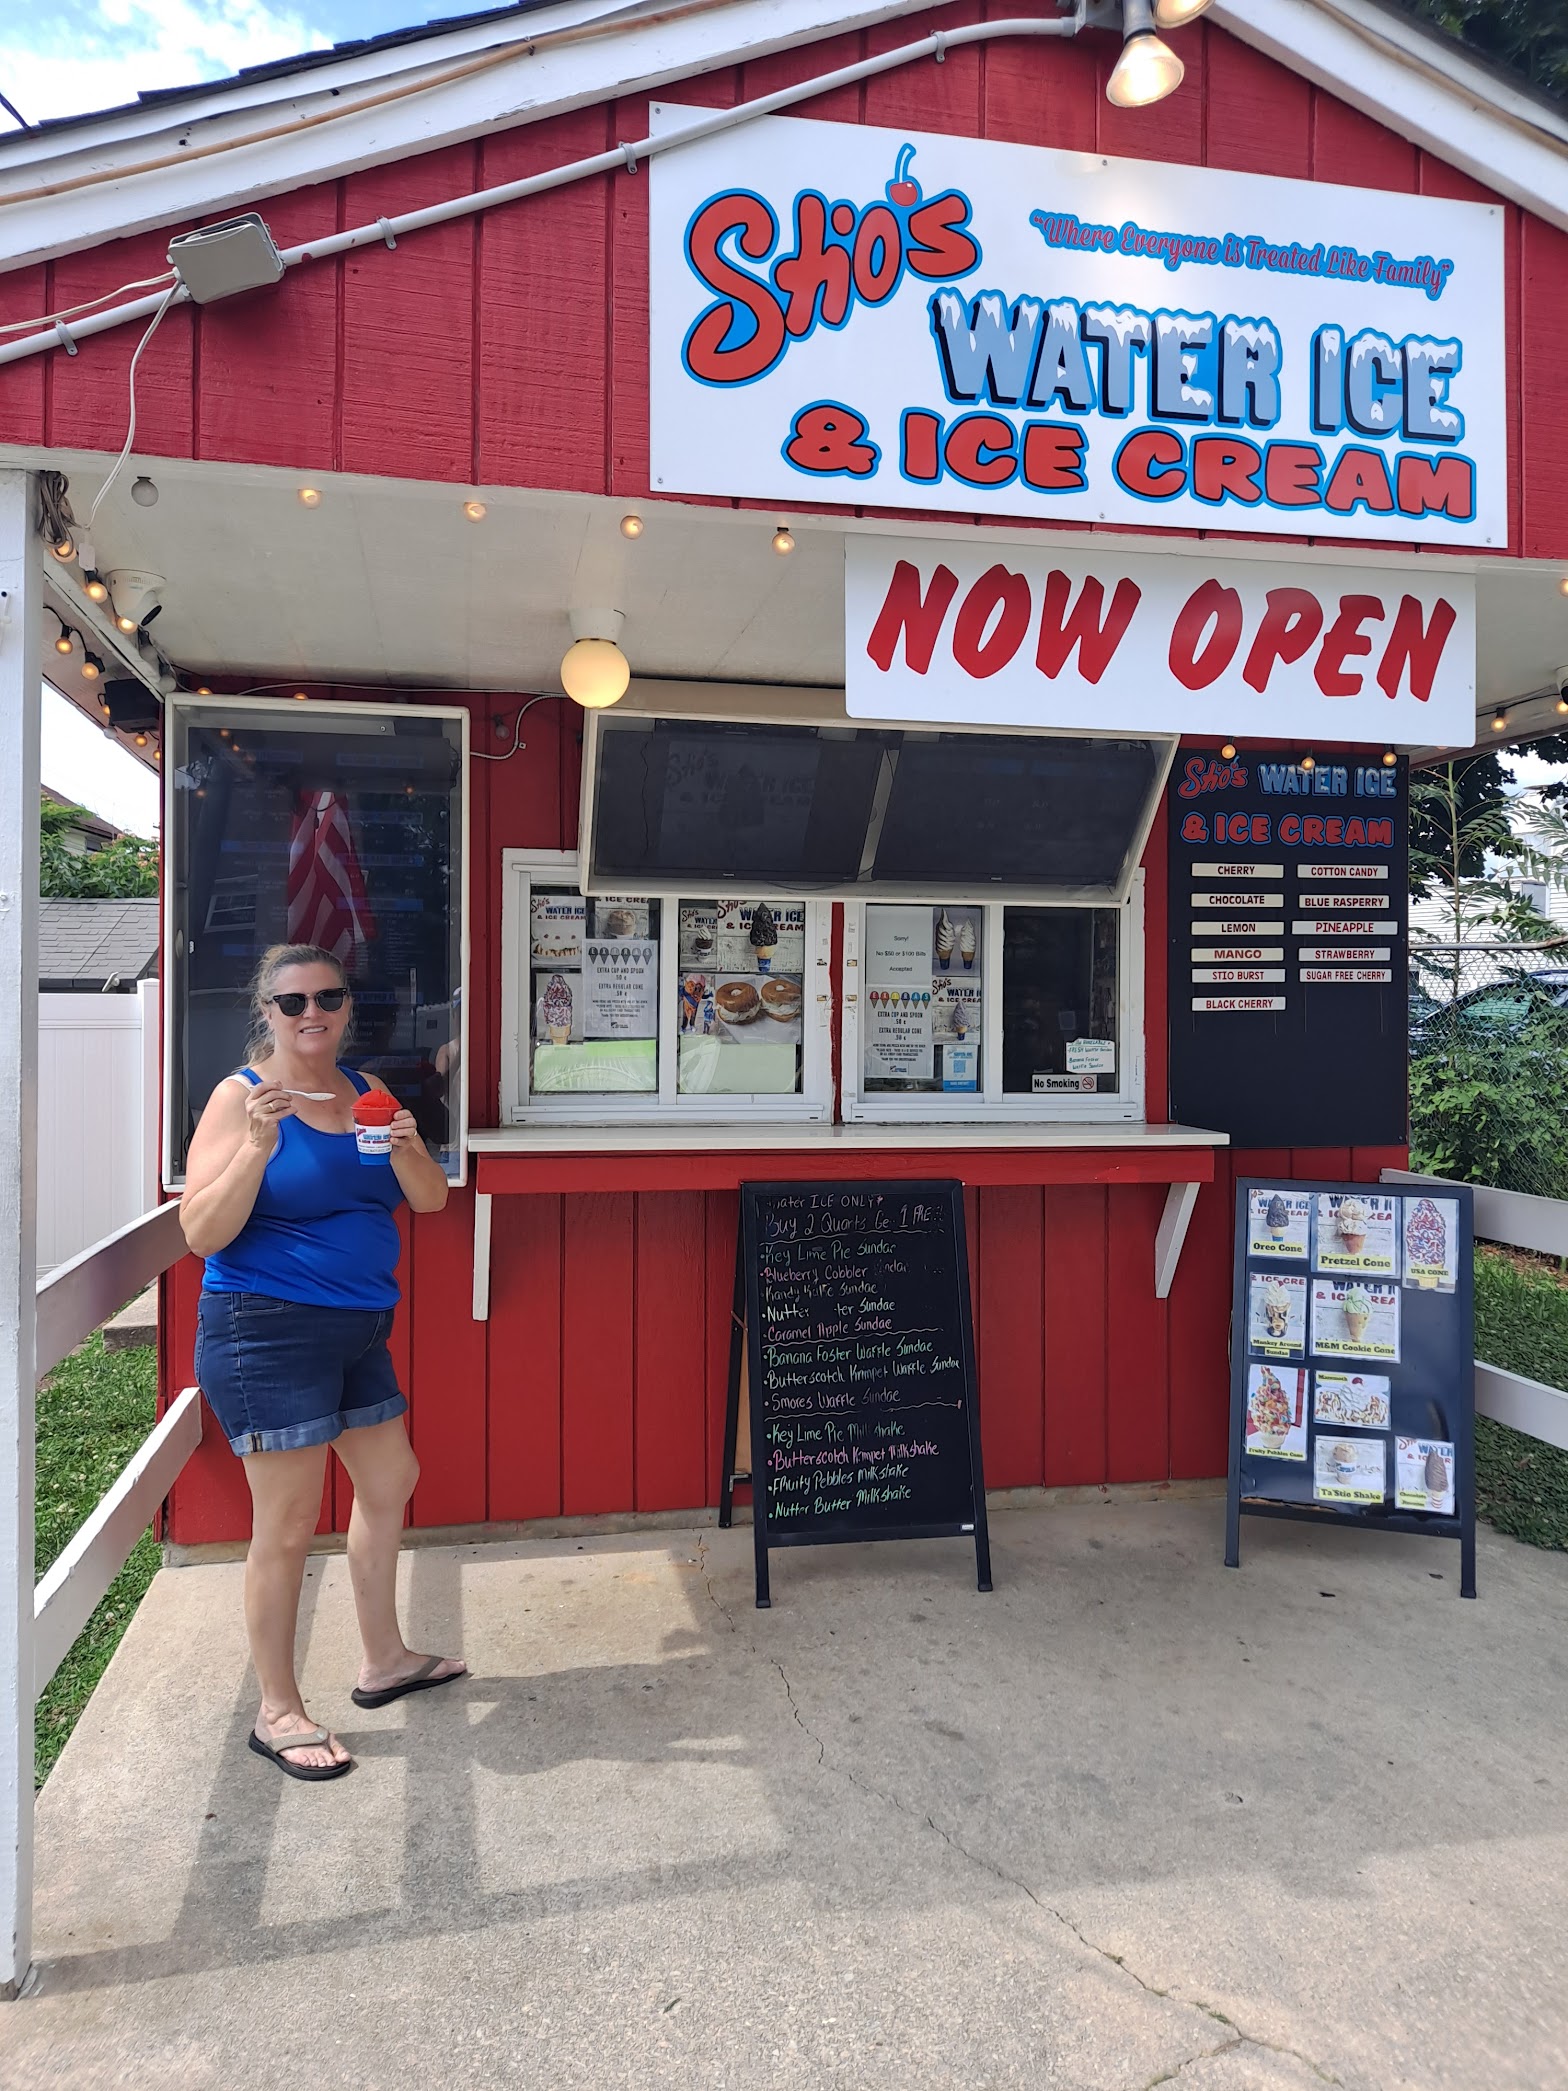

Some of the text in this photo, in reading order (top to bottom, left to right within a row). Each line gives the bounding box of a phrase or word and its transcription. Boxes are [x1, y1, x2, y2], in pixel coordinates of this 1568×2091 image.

[1121, 225, 1217, 268] Everyone
[1224, 237, 1243, 262] is
[1245, 239, 1321, 273] Treated
[1326, 250, 1368, 278] Like
[929, 288, 1464, 444] WATER ICE
[782, 400, 1477, 523] & ICE CREAM
[866, 560, 1458, 703] NOW OPEN
[1258, 763, 1348, 797] WATER
[1354, 767, 1397, 797] ICE
[1180, 812, 1394, 848] & ICE CREAM
[1217, 866, 1255, 875] CHERRY
[1311, 867, 1379, 877] COTTON CANDY
[1209, 896, 1265, 905] CHOCOLATE
[1304, 898, 1384, 907] BLUE RASPERRY
[546, 906, 572, 915] WATER
[785, 907, 804, 922] ICE
[726, 922, 735, 930] &
[1221, 923, 1256, 932] LEMON
[1315, 922, 1375, 933] PINEAPPLE
[1214, 950, 1262, 959] MANGO
[1315, 950, 1375, 959] STRAWBERRY
[1212, 971, 1264, 981] STIO BURST
[1306, 971, 1386, 981] SUGAR FREE CHERRY
[947, 988, 975, 997] WATER
[1206, 999, 1273, 1009] BLACK CHERRY
[1034, 1079, 1080, 1090] No Smoking
[810, 1194, 835, 1209] ICE
[765, 1204, 909, 1240] Buy 2 Quarts 1
[765, 1245, 791, 1266] Key
[798, 1245, 826, 1261] Lime
[831, 1239, 851, 1260] Pie
[1253, 1242, 1303, 1253] Oreo Cone
[1321, 1255, 1391, 1268] Pretzel Cone
[763, 1263, 868, 1286] Blueberry Cobbler
[1410, 1268, 1449, 1277] USA CONE
[840, 1281, 878, 1297] Sundae
[1316, 1292, 1325, 1300] &
[858, 1298, 896, 1313] Sundae
[767, 1316, 893, 1342] Caramel Apple Sundae
[767, 1336, 934, 1368] Banana Foster Waffle Sundae
[1315, 1341, 1396, 1355] M&M Cookie Cone
[768, 1366, 846, 1390] Butterscotch
[892, 1359, 926, 1376] Waffle
[772, 1387, 901, 1411] Smores Waffle Sundae
[772, 1421, 845, 1450] Key Lime Pie
[773, 1447, 849, 1471] Butterscotch
[813, 1470, 854, 1489] Pebbles
[857, 1463, 910, 1482] Milkshake
[1354, 1490, 1381, 1501] Shake
[775, 1486, 912, 1520] Nutter Butter Milkshake
